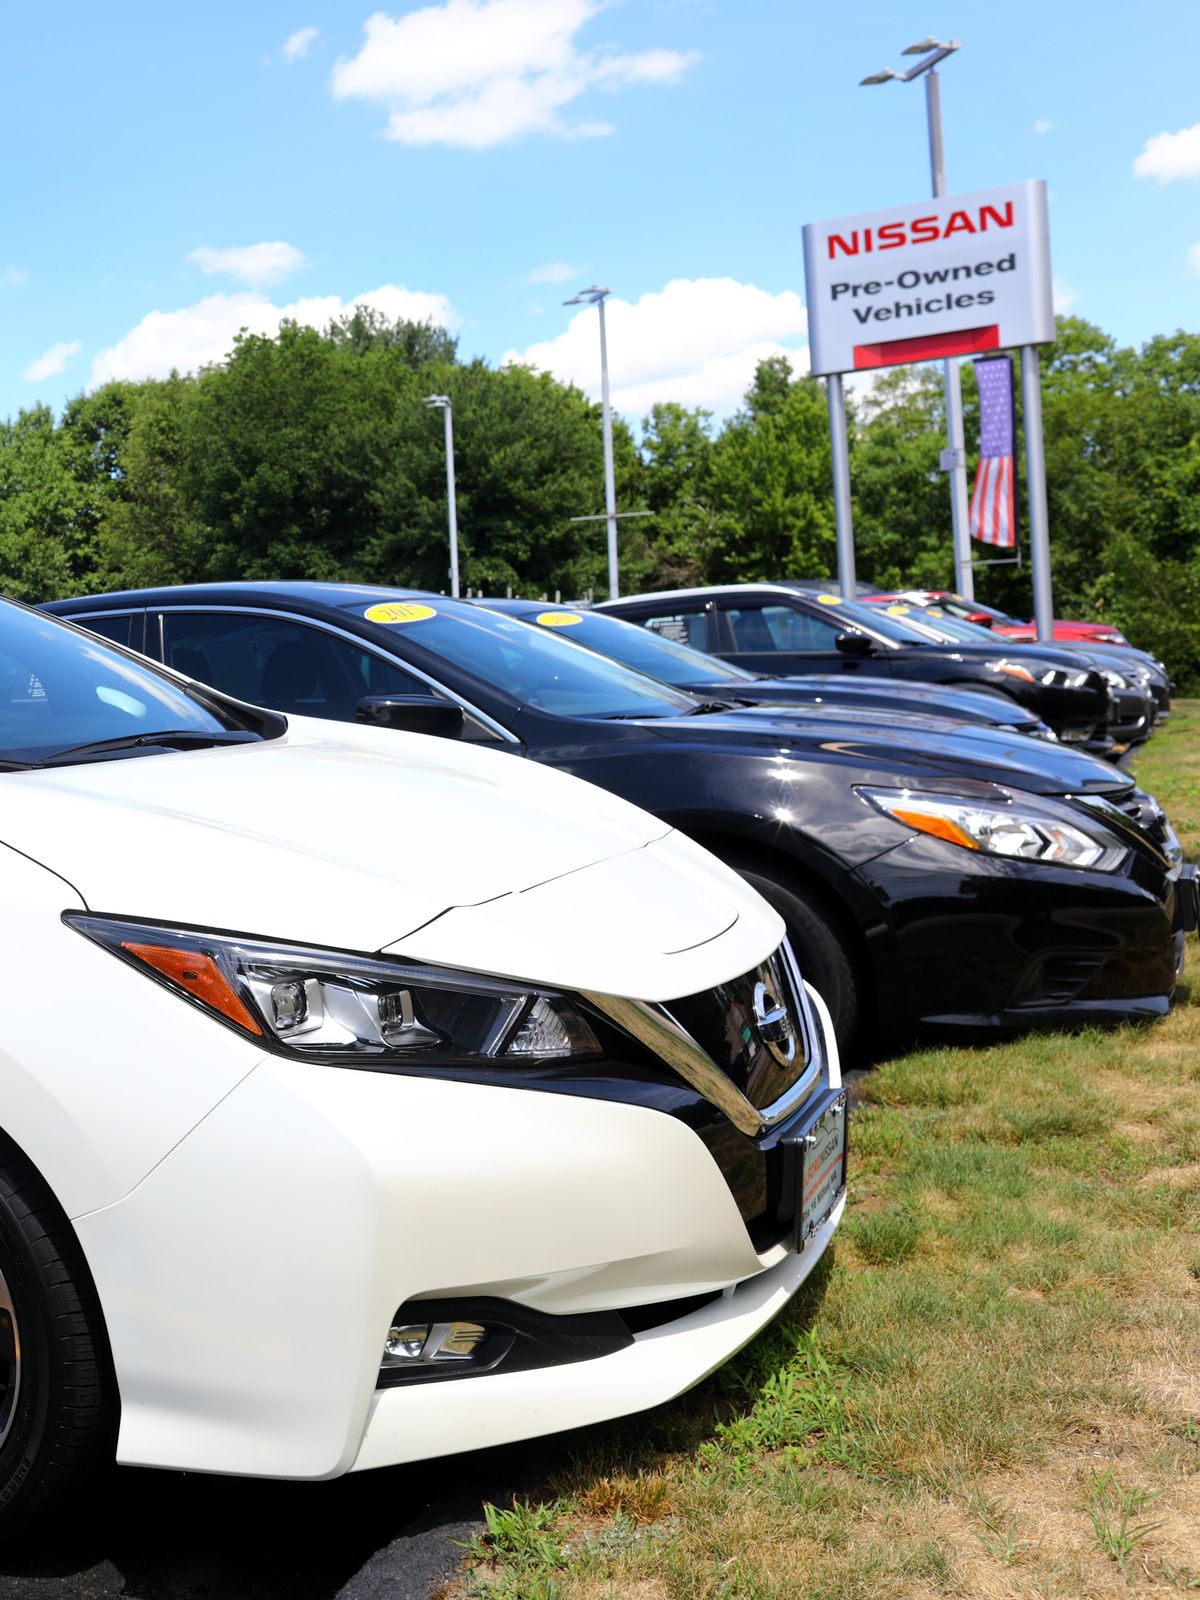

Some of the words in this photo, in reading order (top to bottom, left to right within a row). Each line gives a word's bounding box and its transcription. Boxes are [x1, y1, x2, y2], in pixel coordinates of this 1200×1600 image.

[827, 201, 1014, 259] NISSAN
[831, 253, 1016, 301] Pre-Owned
[853, 289, 995, 324] Vehicles
